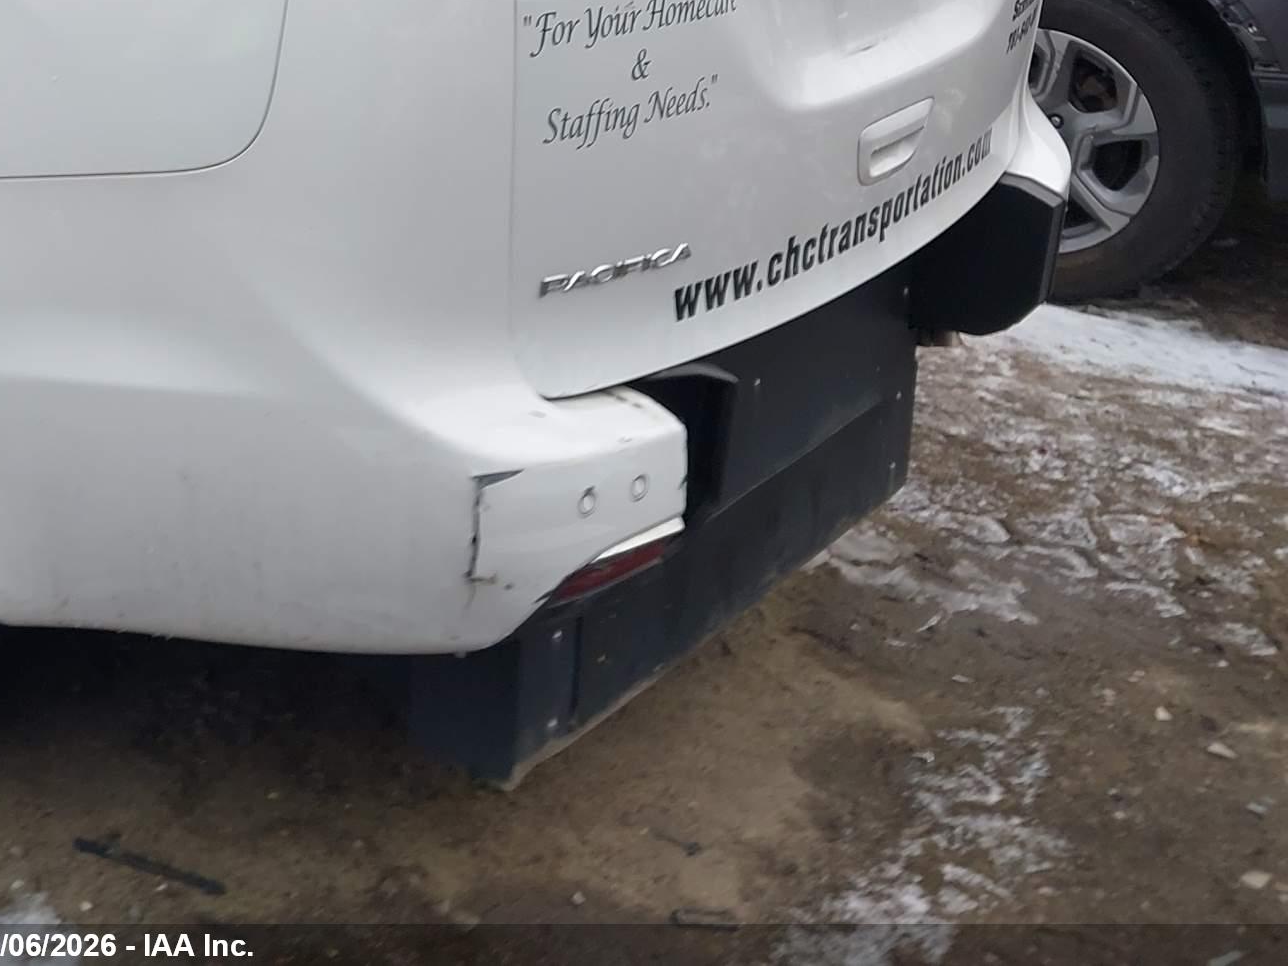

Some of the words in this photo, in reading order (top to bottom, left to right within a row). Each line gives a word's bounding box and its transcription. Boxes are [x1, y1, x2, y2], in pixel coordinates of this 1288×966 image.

[584, 6, 642, 49] Your
[631, 48, 652, 81] &
[542, 97, 641, 151] Staffing
[674, 128, 994, 322] www.chctransportation.com
[539, 242, 693, 299] PACIFICA
